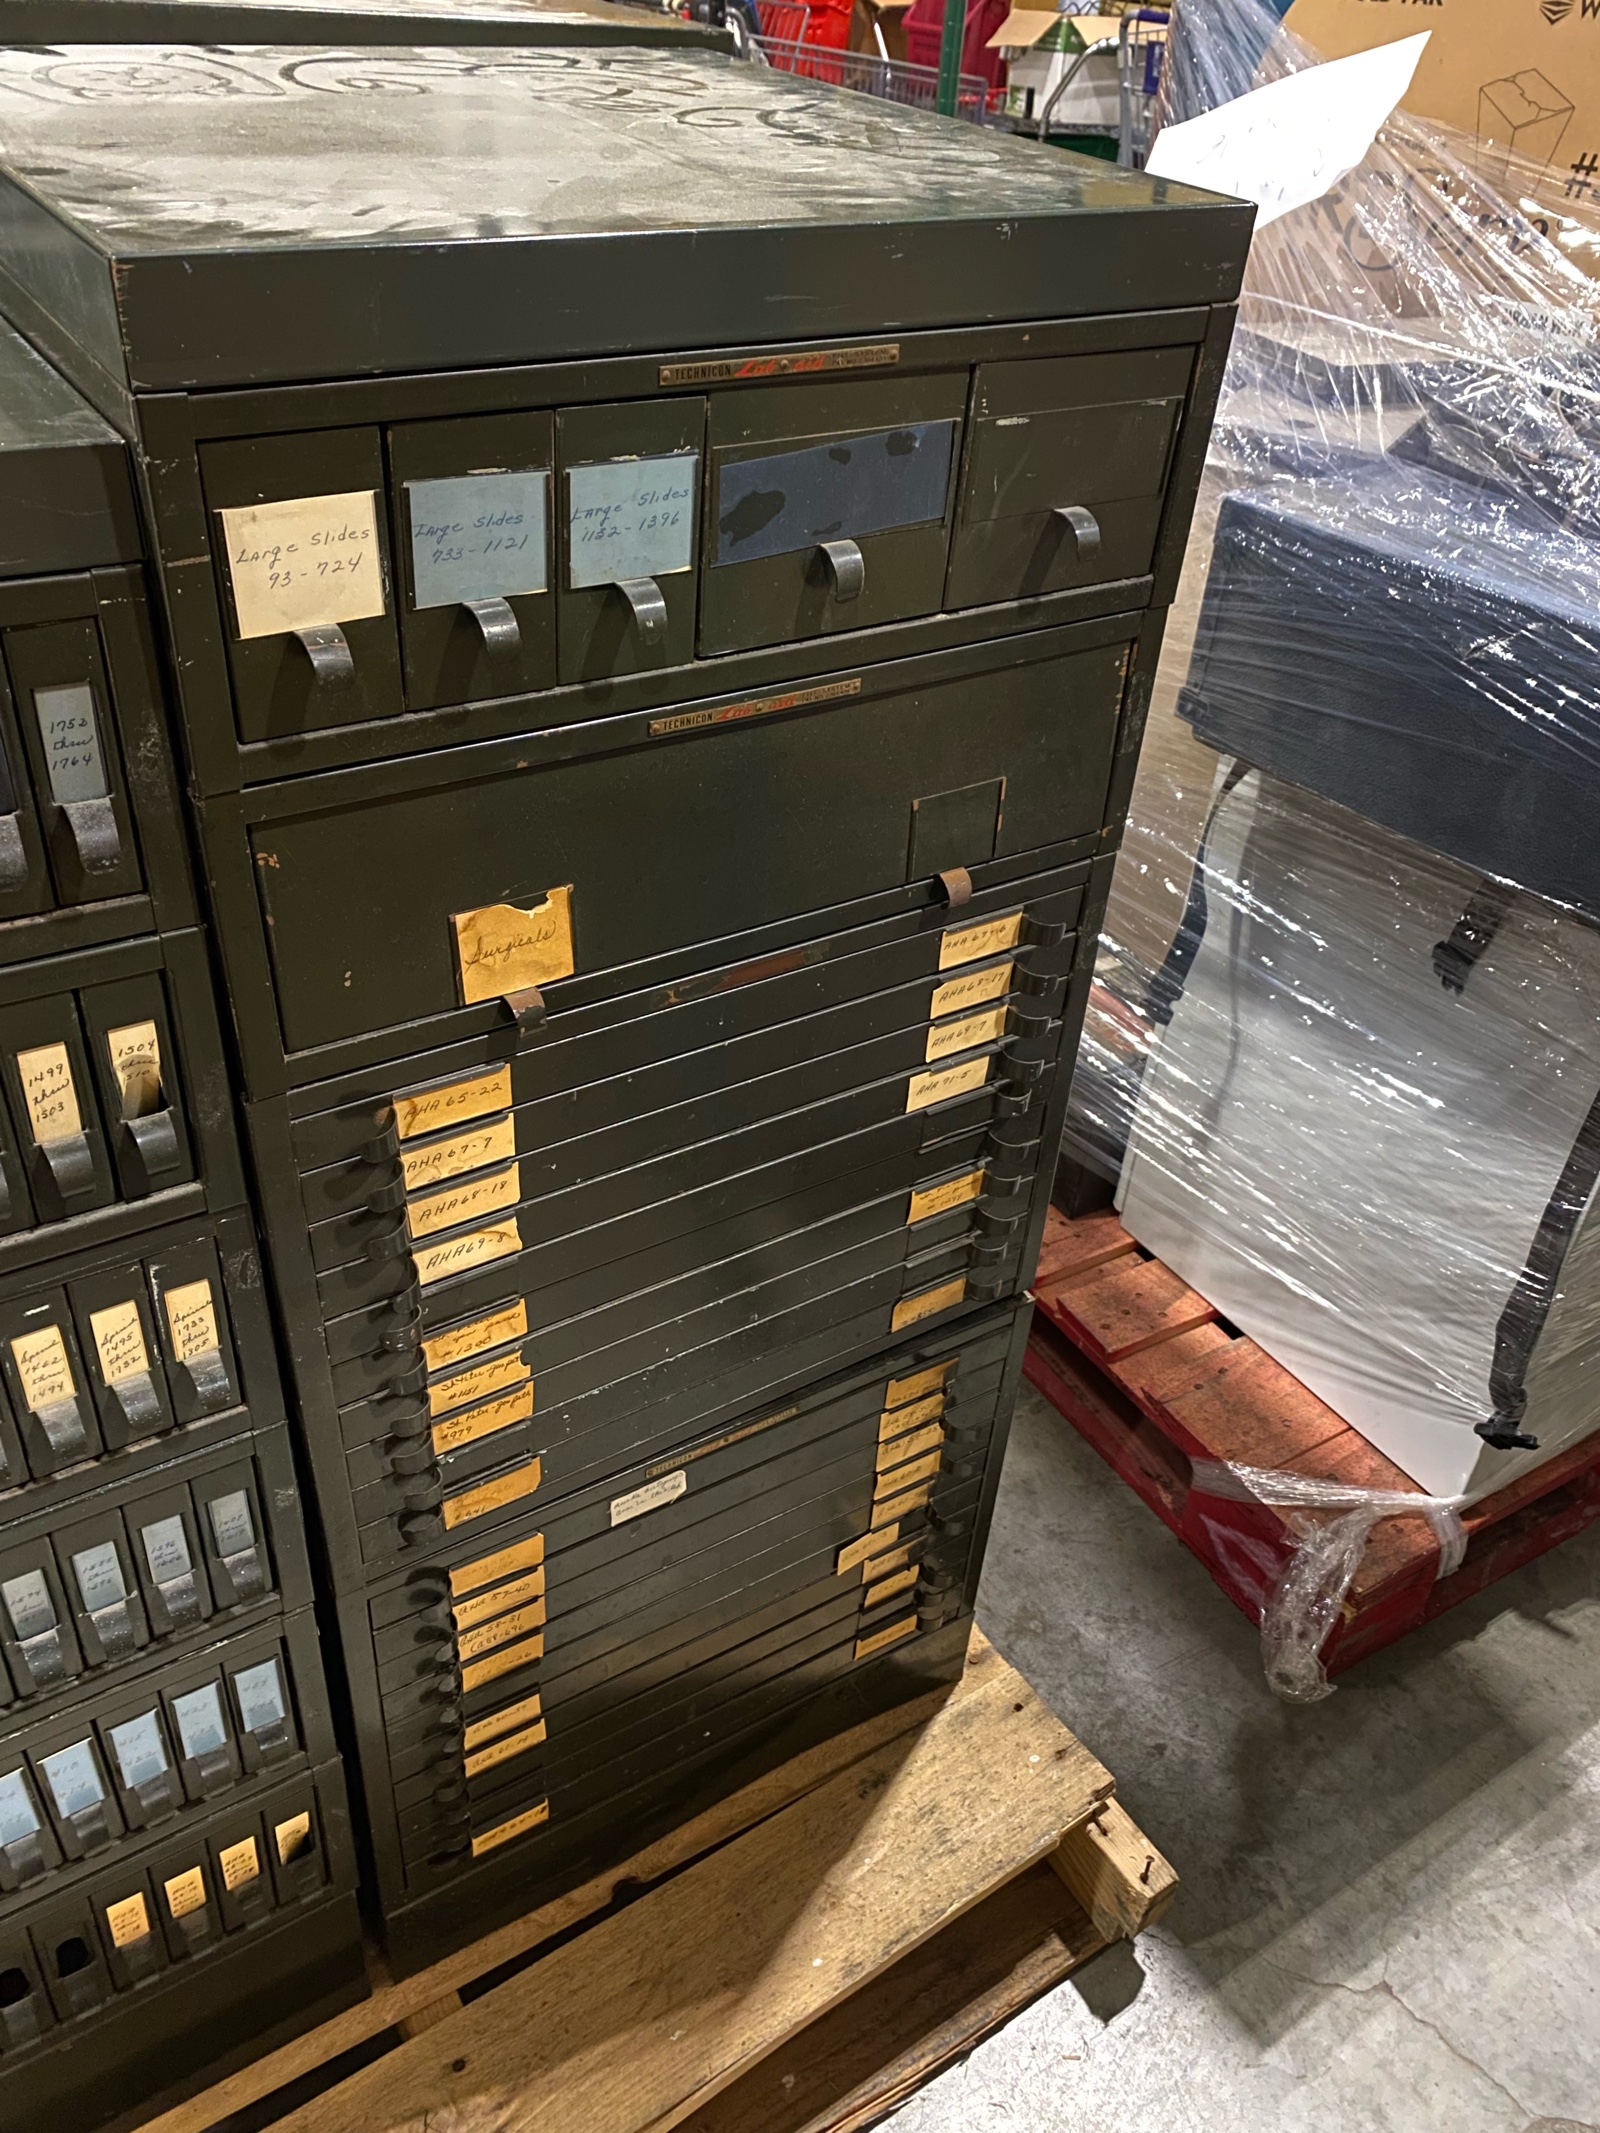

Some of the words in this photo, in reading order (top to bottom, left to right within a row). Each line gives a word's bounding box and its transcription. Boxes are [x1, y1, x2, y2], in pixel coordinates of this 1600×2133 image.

[675, 364, 731, 380] TECHNICON
[570, 503, 624, 525] Large
[638, 486, 690, 508] Slides
[473, 510, 525, 528] Slides
[236, 540, 299, 568] Large
[310, 526, 371, 546] Slides
[50, 718, 88, 734] 1752
[663, 712, 713, 731] TECHNICON
[52, 753, 93, 771] 1764
[944, 936, 967, 951] AHA
[118, 1039, 156, 1057] 1504
[28, 1063, 64, 1087] 1499
[123, 1069, 151, 1083] 1510
[915, 1081, 938, 1097] AHA
[36, 1101, 65, 1123] 1503
[403, 1099, 441, 1121] AHA
[406, 1152, 443, 1174] AHA
[106, 1331, 134, 1356] 1495
[655, 1453, 693, 1473] TECHNICON
